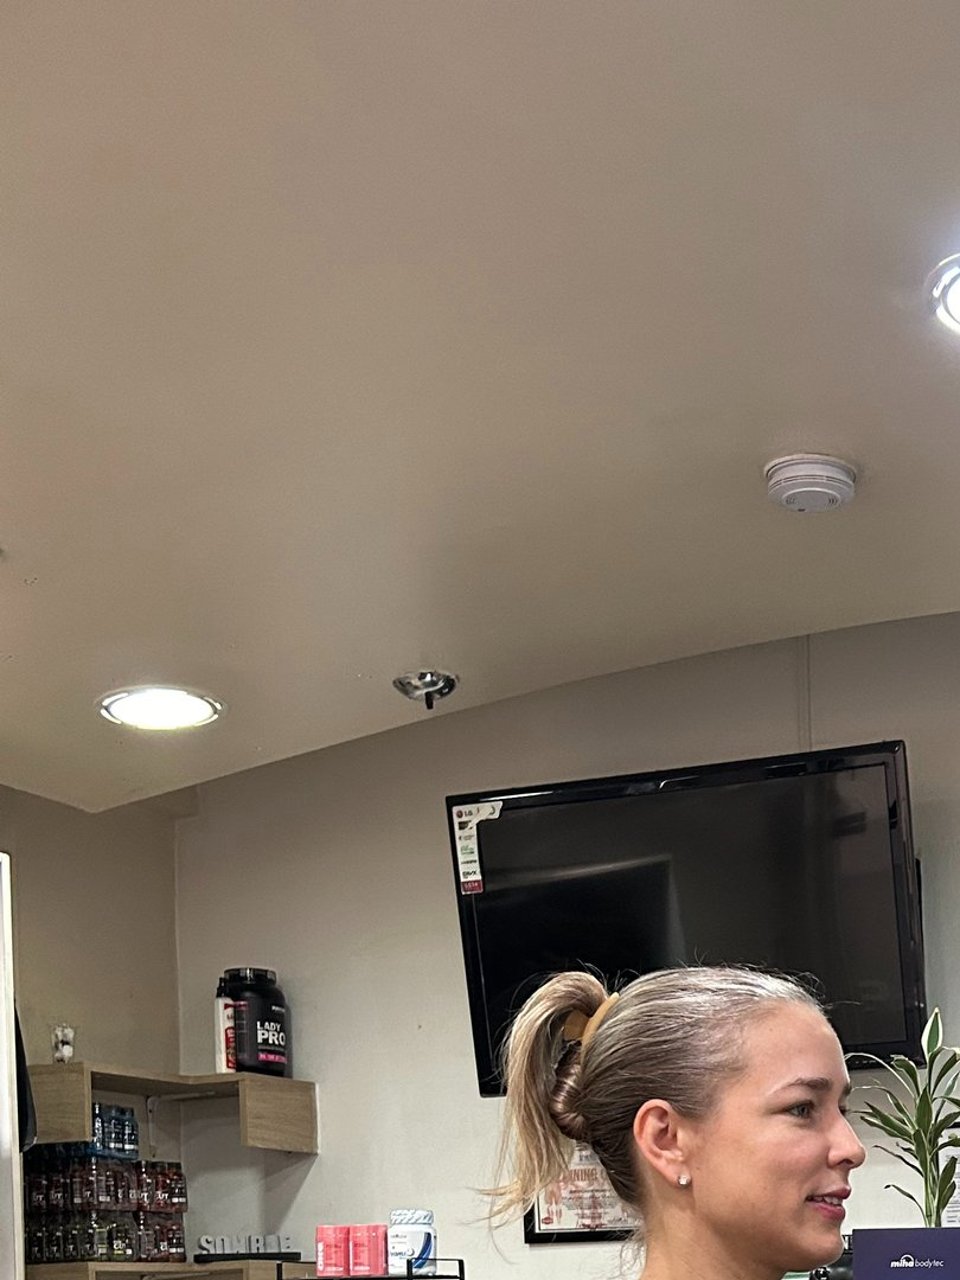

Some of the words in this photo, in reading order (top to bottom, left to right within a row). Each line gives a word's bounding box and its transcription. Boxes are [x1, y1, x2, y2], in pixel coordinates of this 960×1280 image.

[257, 1021, 281, 1032] LADY
[257, 1030, 286, 1046] PRO
[890, 1256, 914, 1268] miha
[914, 1259, 944, 1269] bodytec
